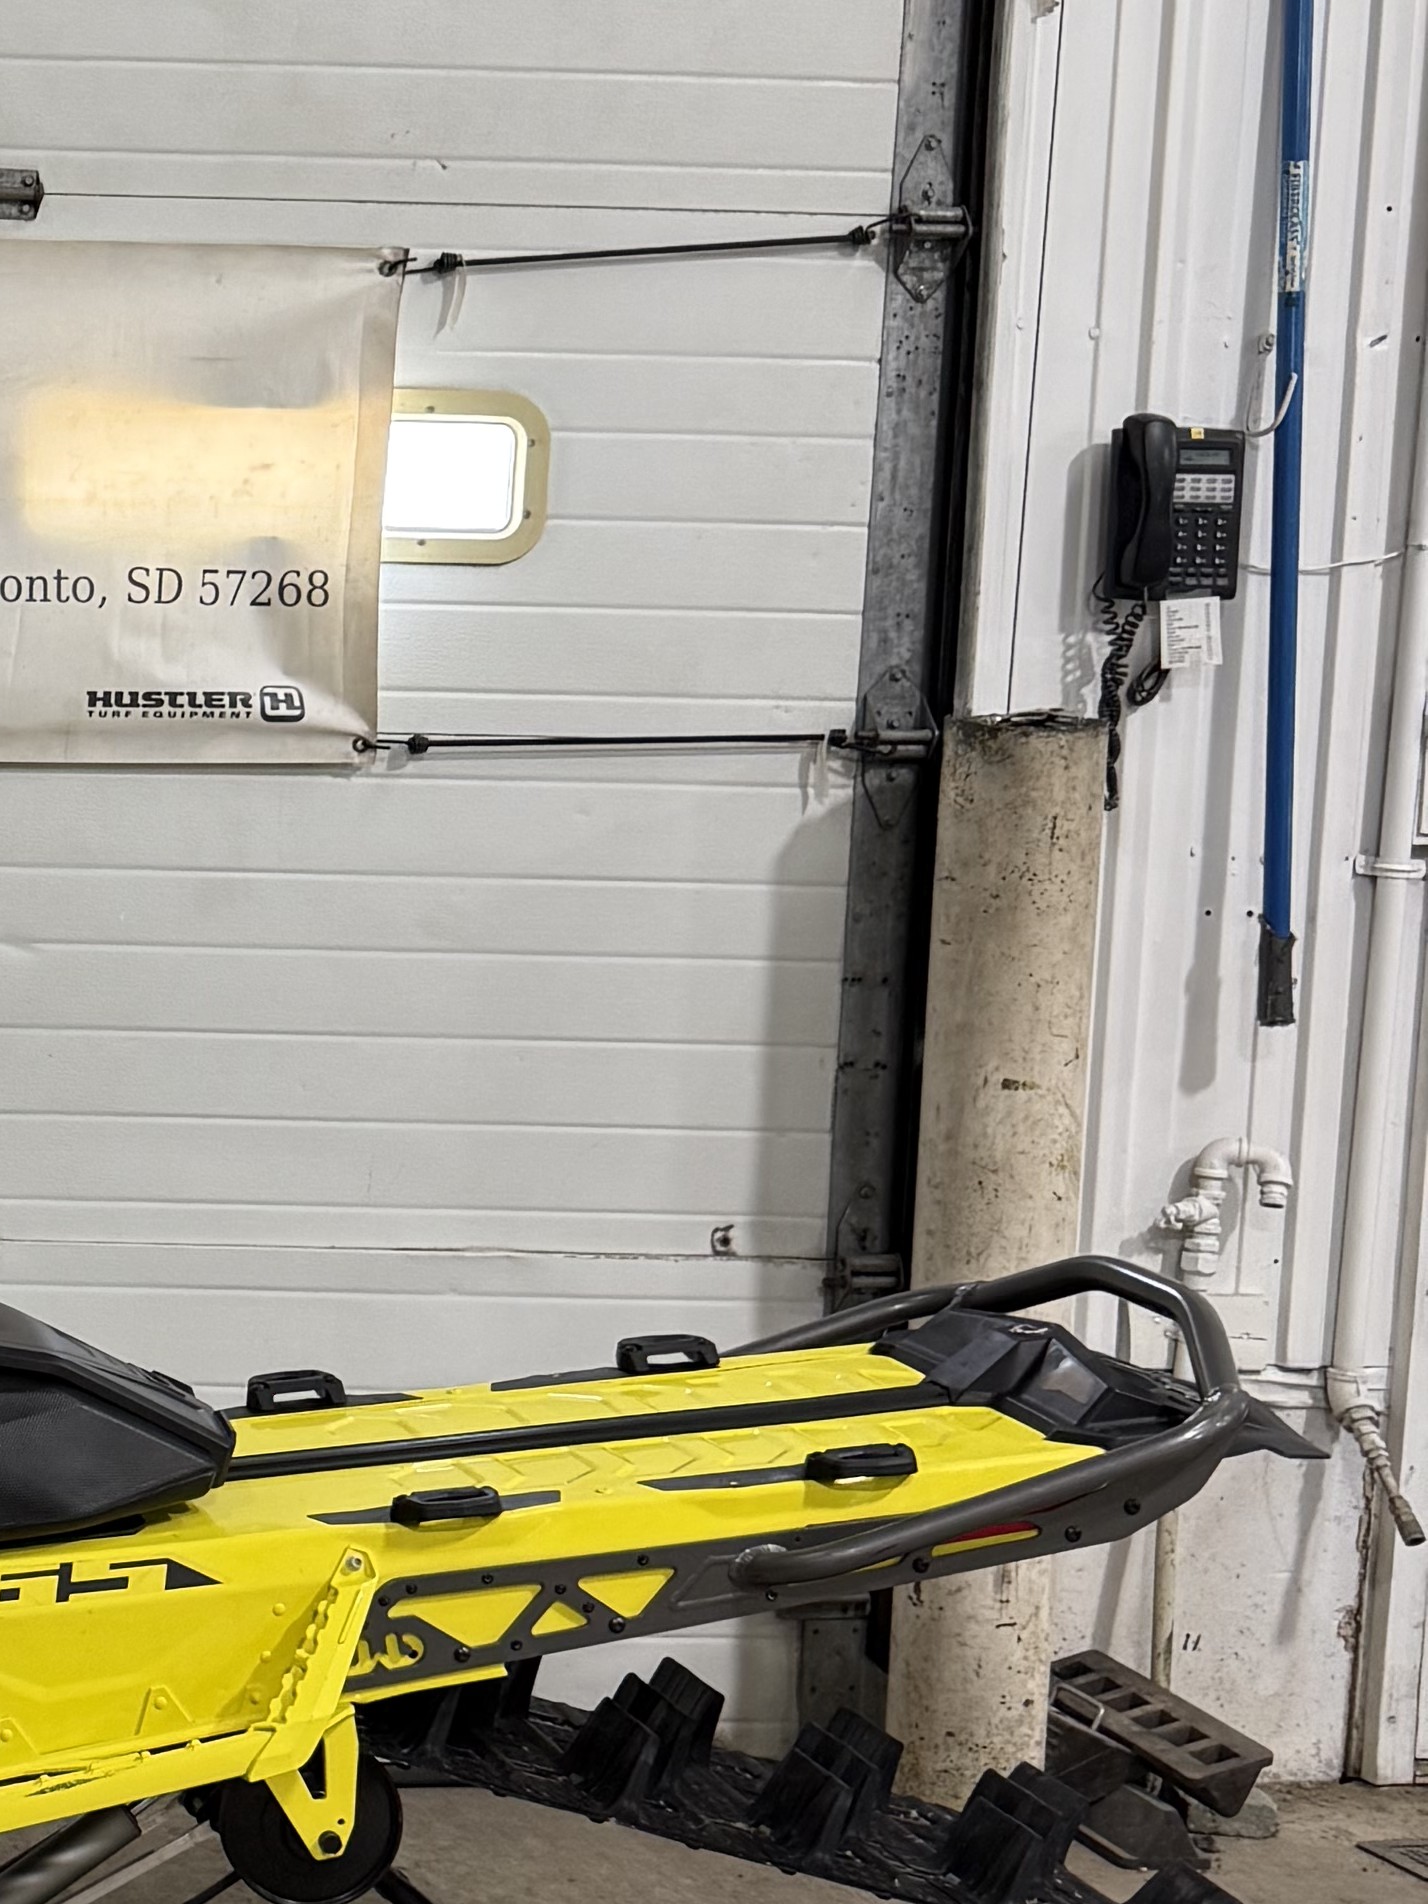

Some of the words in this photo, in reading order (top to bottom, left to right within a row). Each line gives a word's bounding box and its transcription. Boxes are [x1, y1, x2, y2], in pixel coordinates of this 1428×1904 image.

[127, 566, 183, 605] SD
[198, 569, 330, 607] 57268
[86, 690, 253, 709] HUSTLER
[88, 710, 132, 719] TURF
[142, 710, 253, 719] EQUIPMENT
